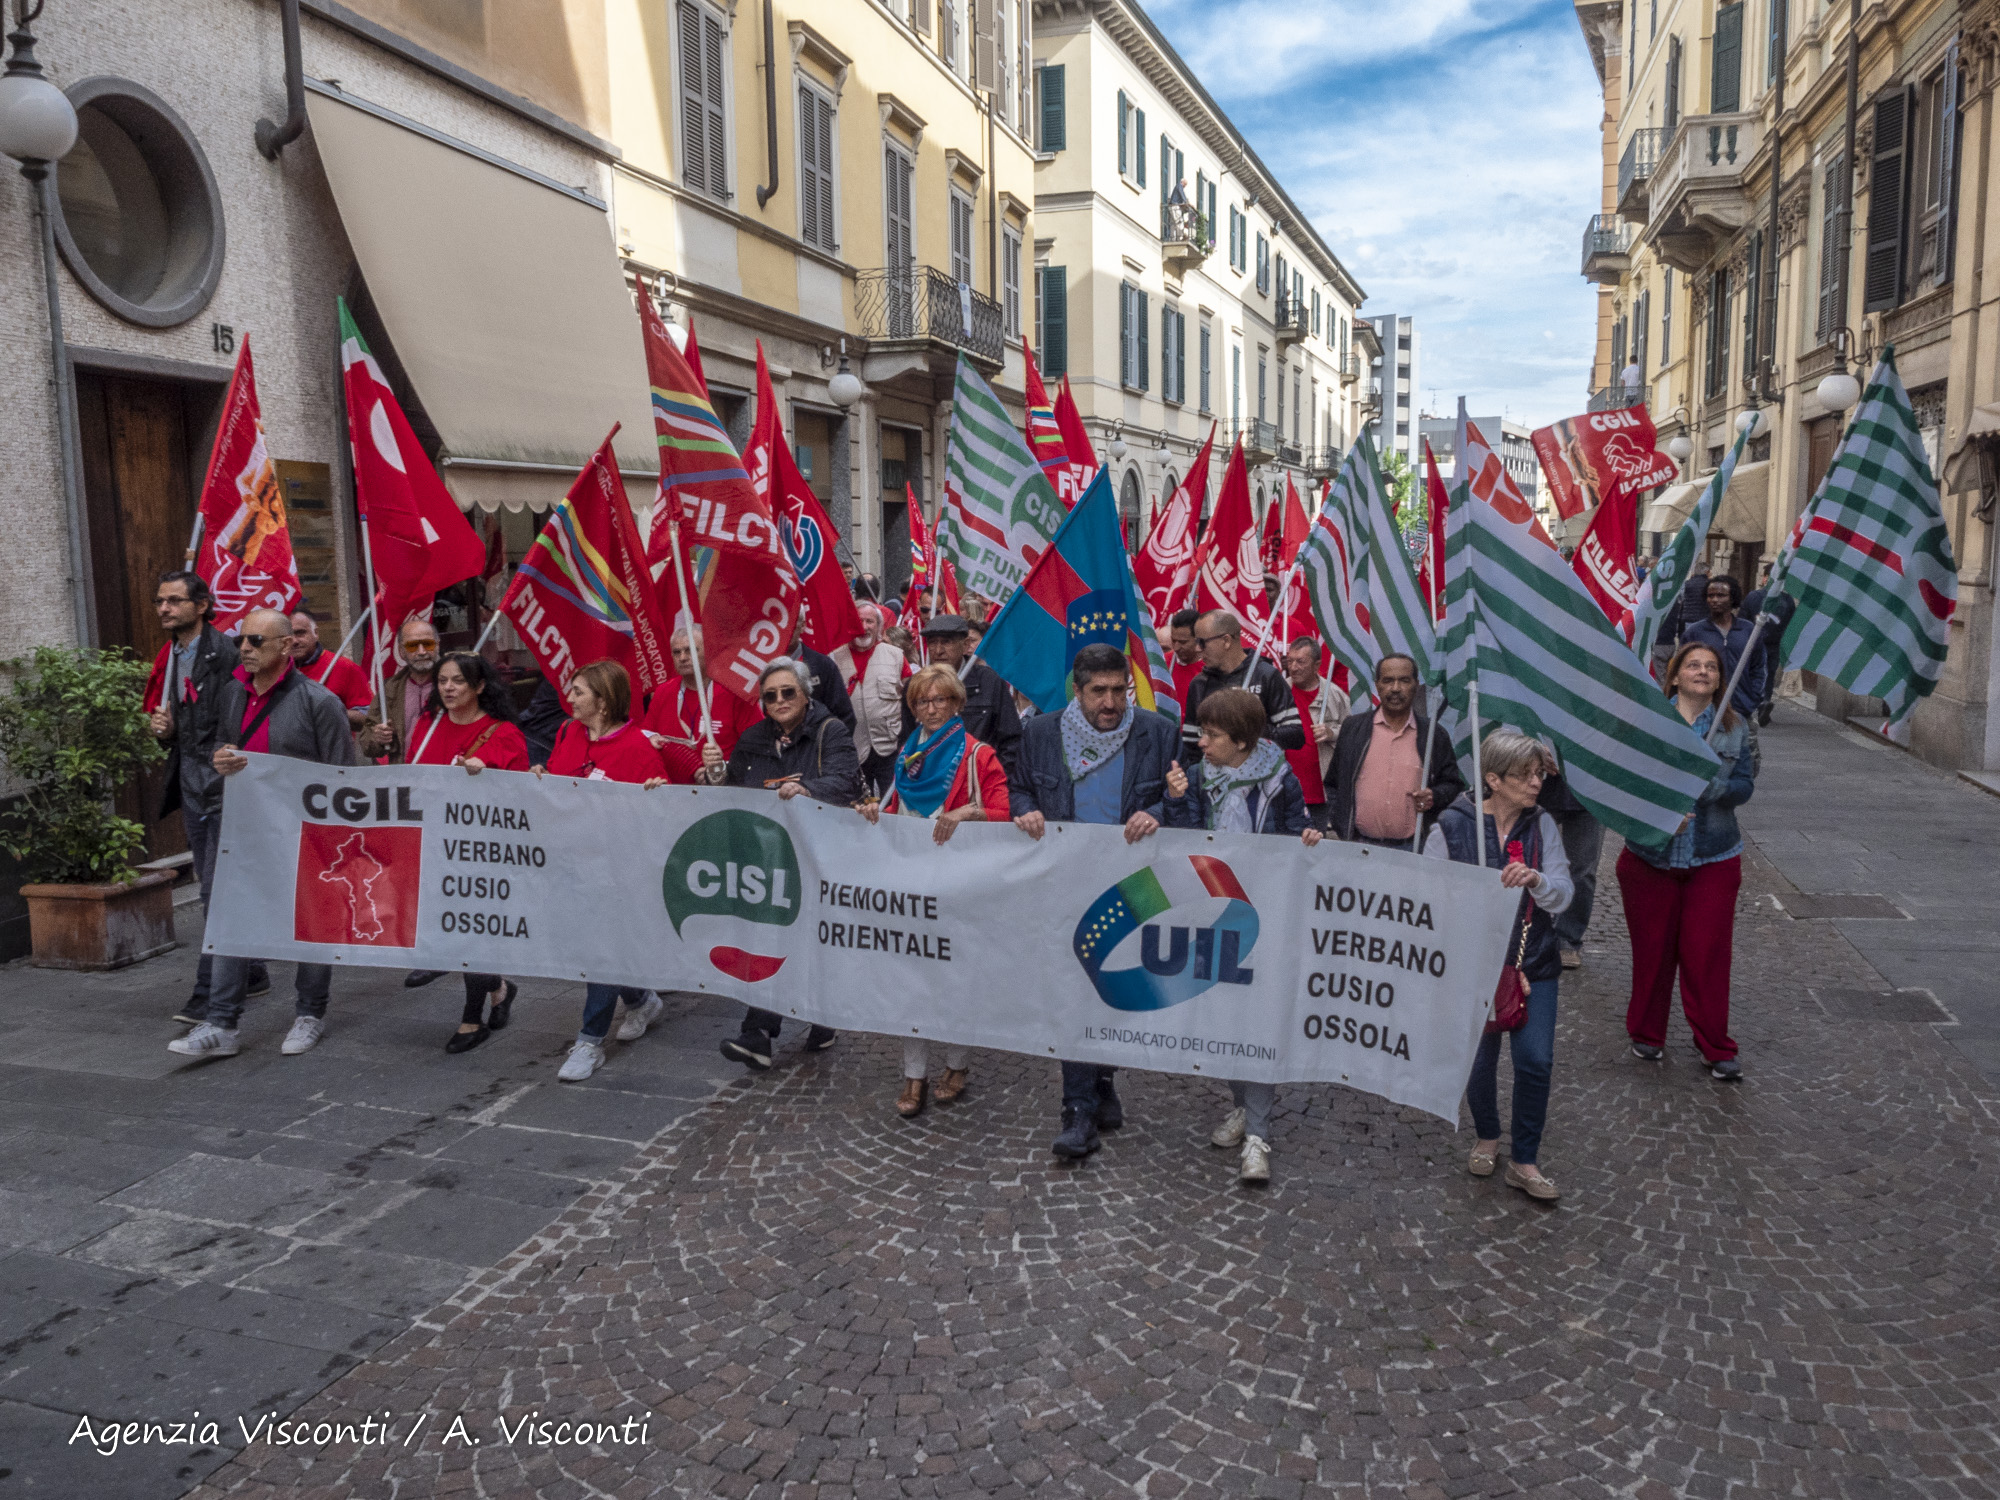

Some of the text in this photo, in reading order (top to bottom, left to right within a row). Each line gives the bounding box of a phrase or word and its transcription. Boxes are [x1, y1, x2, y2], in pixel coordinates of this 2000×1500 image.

[210, 322, 235, 354] 15
[1589, 410, 1642, 432] CGIL
[1619, 466, 1673, 495] ILCAMS
[1024, 491, 1063, 535] CIS
[980, 547, 1028, 585] FUN
[1585, 528, 1637, 602] FILLEA
[1656, 547, 1677, 600] ISL
[636, 609, 669, 685] LAVORATORI
[302, 782, 424, 822] CGIL
[445, 802, 530, 832] NOVARA
[443, 838, 546, 868] VERBANO
[441, 875, 511, 900] CUSIO
[686, 859, 792, 909] CISL
[819, 879, 938, 920] PIEMONTE
[441, 911, 530, 939] OSSOLA
[1314, 884, 1435, 931] NOVARA
[818, 920, 952, 962] ORIENTALE
[1140, 923, 1255, 985] UIL
[1311, 927, 1446, 978] VERBANO
[1307, 971, 1395, 1008] CUSIO
[1084, 1025, 1277, 1061] IL SINDACATO DEI CITTADINI
[1303, 1014, 1412, 1062] OSSOLA
